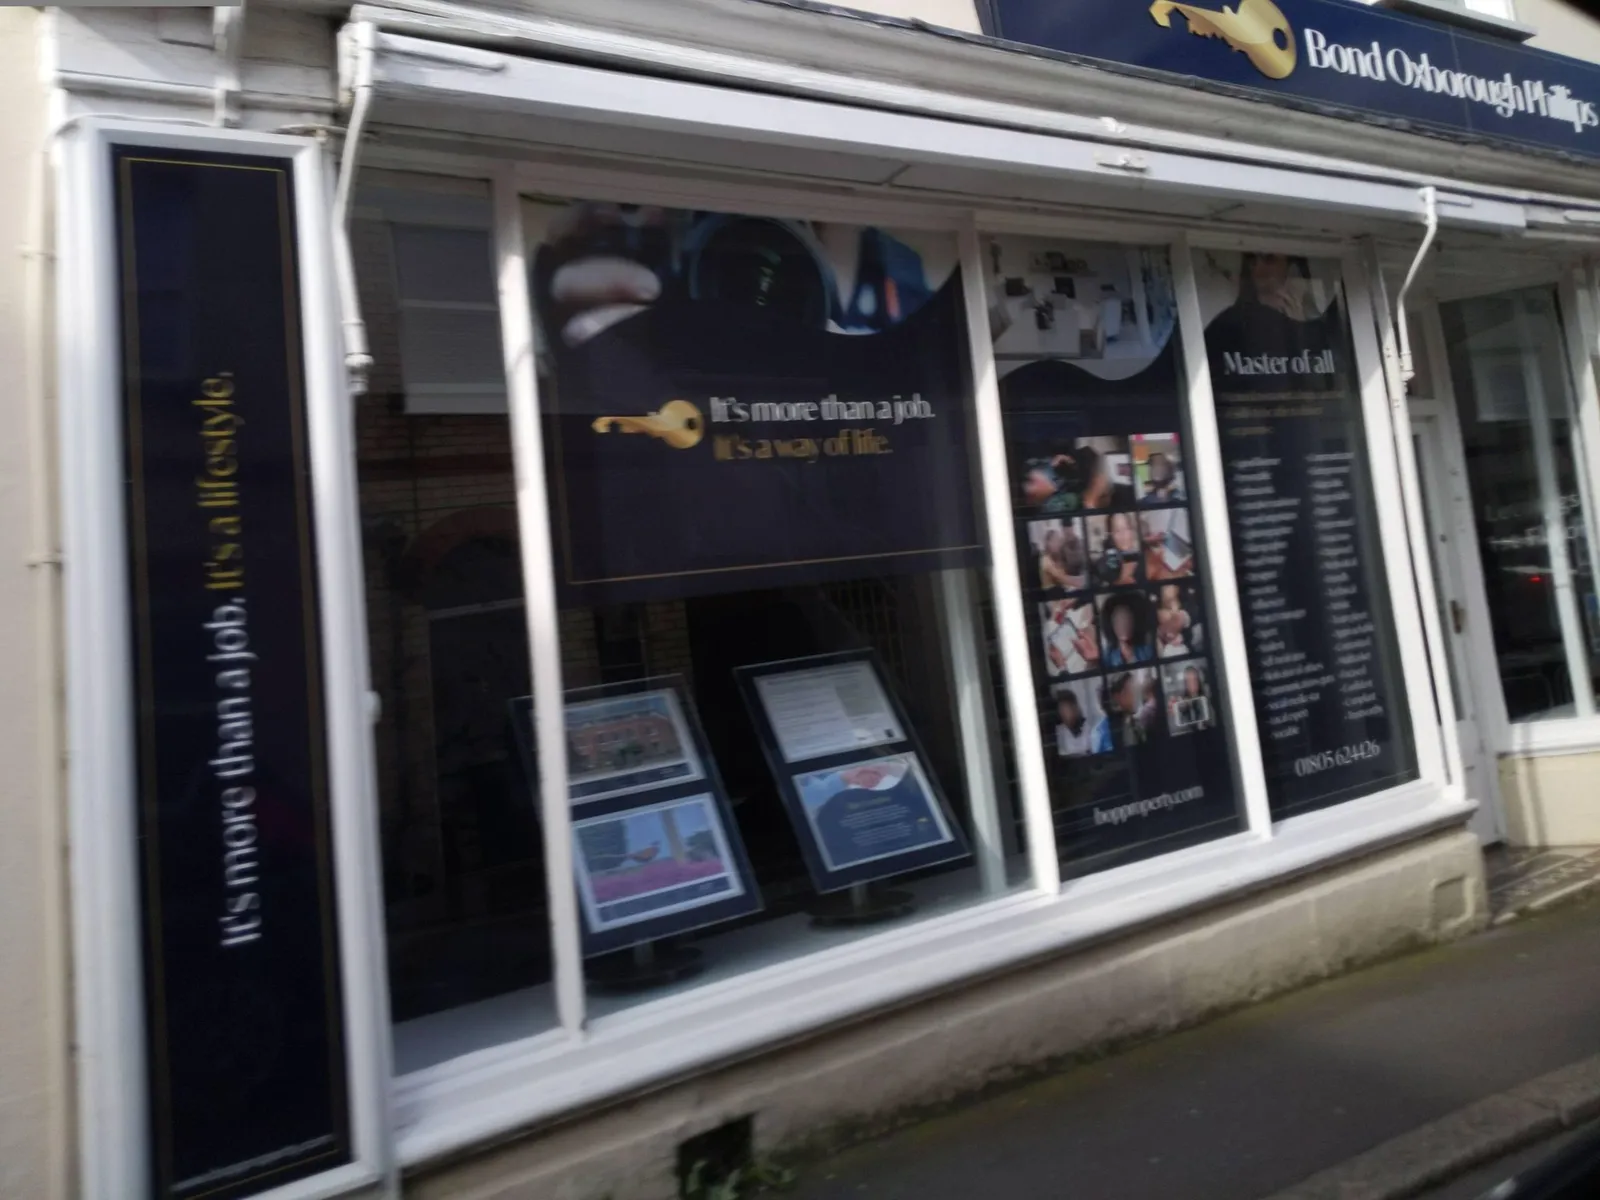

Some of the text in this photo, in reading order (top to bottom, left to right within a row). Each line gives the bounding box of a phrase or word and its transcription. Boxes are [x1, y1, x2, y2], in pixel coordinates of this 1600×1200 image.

[1304, 27, 1599, 133] Bond Oxborough Phillips
[1223, 349, 1335, 376] Master of all
[709, 393, 935, 425] It's more than a job.
[713, 428, 893, 463] It's a way of life.
[192, 371, 262, 948] It's more than a job. It's a lifestyle.
[1335, 739, 1382, 766] 624426
